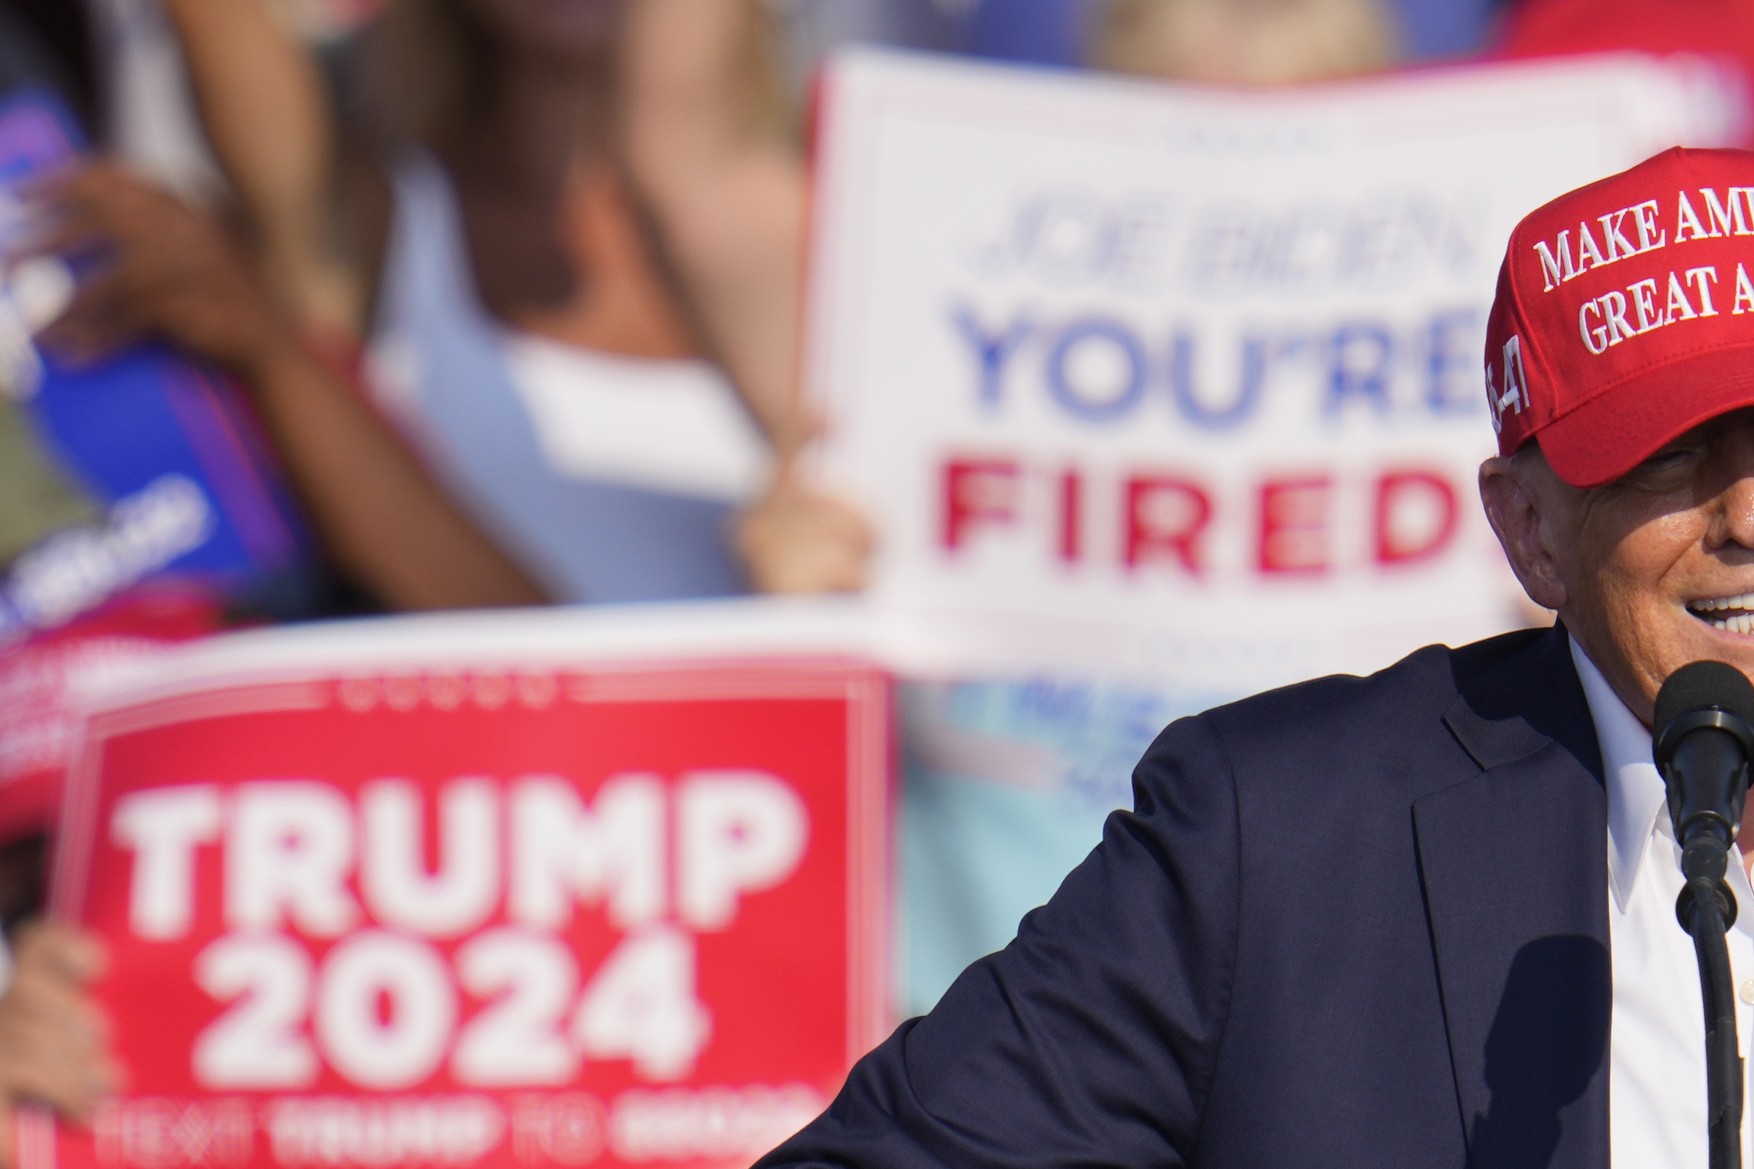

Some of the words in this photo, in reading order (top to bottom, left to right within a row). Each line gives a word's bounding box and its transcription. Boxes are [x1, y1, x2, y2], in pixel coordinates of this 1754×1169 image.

[1533, 200, 1666, 293] MAKE
[946, 299, 1484, 431] YOU'RE
[1578, 266, 1719, 355] GREAT
[938, 456, 1466, 578] FIRED
[113, 772, 806, 940] TRUMP
[193, 922, 711, 1089] 2024
